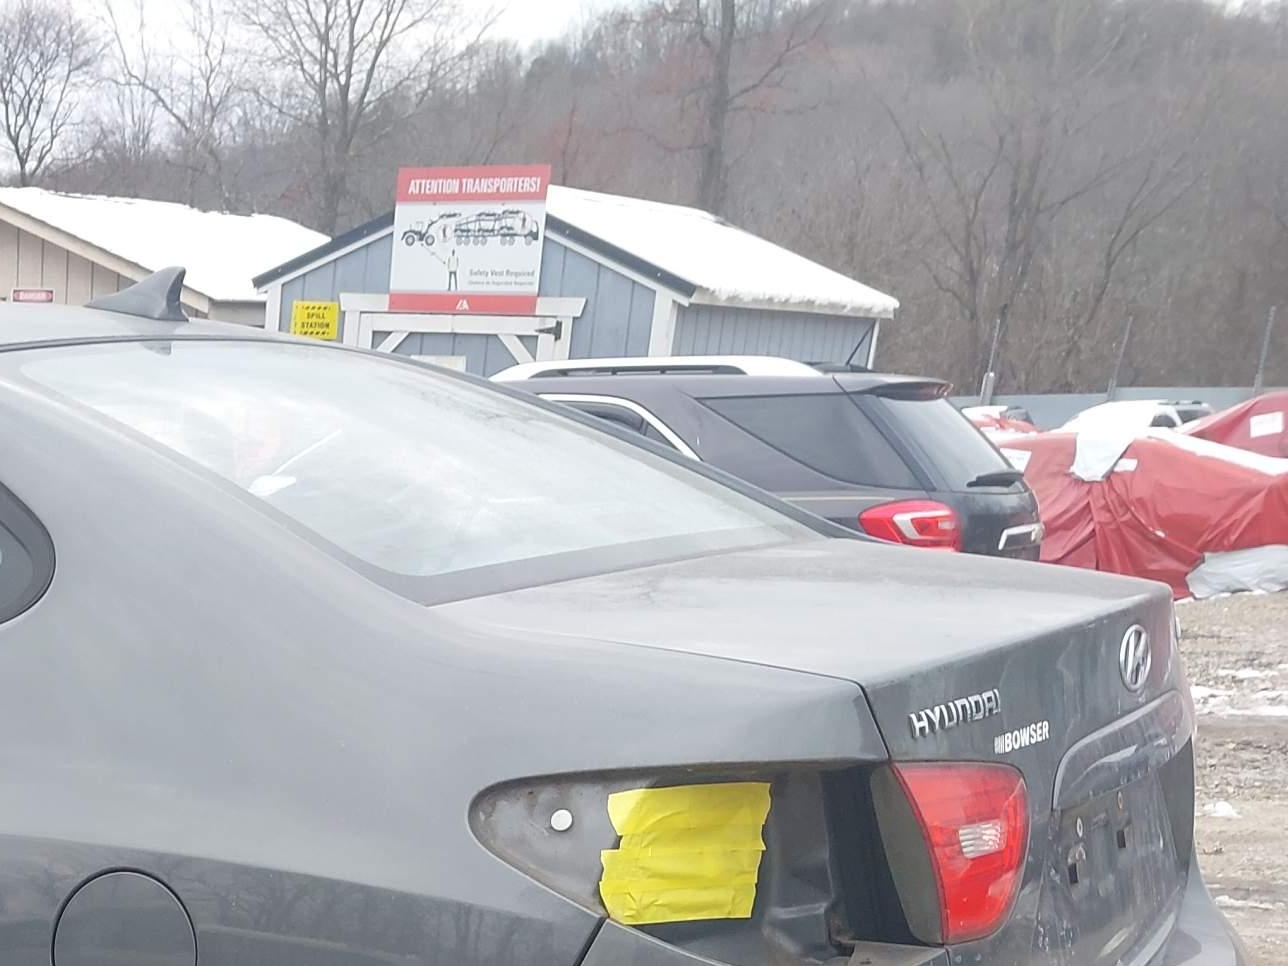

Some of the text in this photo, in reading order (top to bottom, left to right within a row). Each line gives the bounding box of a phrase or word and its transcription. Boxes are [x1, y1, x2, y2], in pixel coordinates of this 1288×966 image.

[408, 176, 541, 195] ATTENTION TRANSPORTERS!
[302, 321, 330, 329] STATION
[910, 689, 1001, 738] HYUNDAI
[1005, 720, 1049, 754] BOWSER
